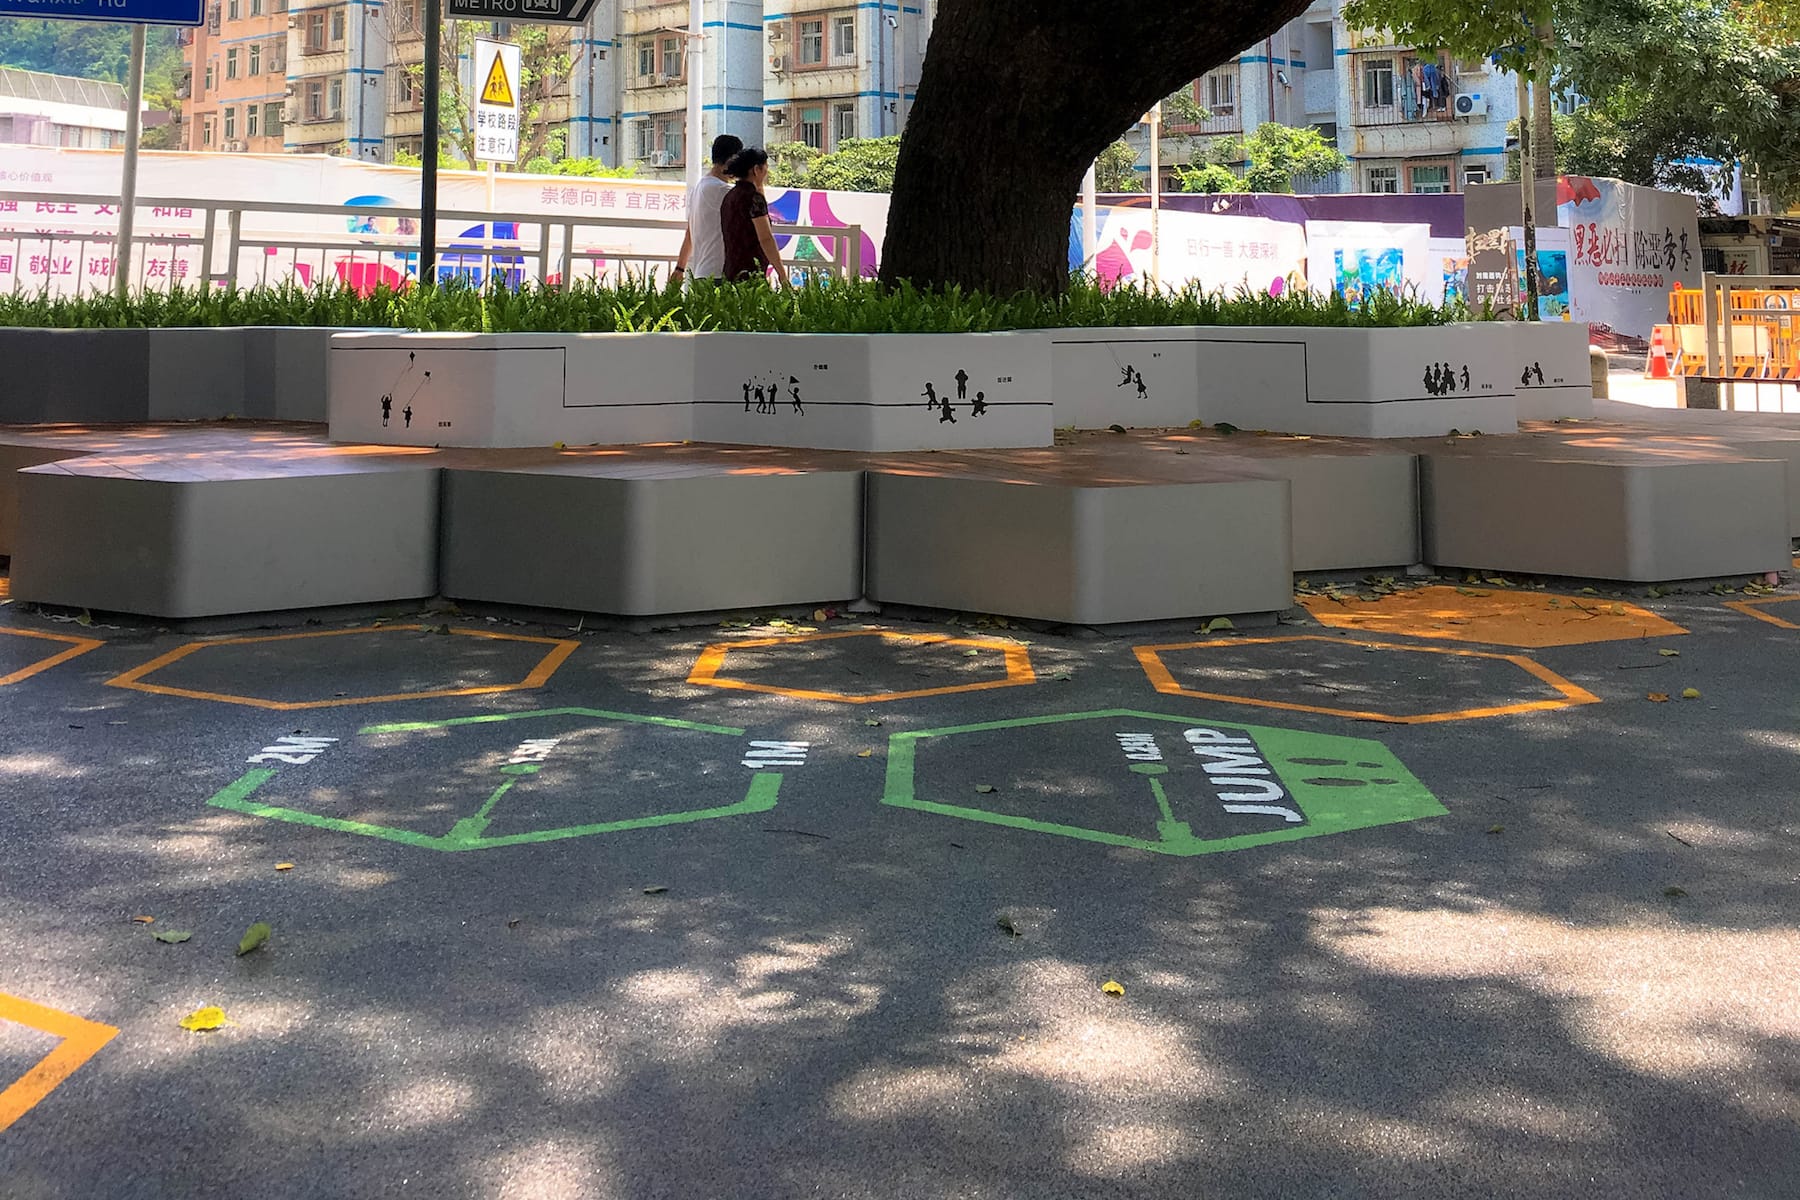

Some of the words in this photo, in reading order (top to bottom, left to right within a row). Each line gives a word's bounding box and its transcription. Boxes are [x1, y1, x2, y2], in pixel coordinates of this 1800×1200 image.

[478, 110, 516, 130] 学校路段
[478, 135, 515, 154] 注意行人
[541, 186, 616, 208] 崇德向善
[625, 191, 687, 211] 宜居深
[29, 255, 72, 275] 敬业
[147, 258, 189, 278] 友善
[245, 737, 340, 764] 2M
[741, 741, 810, 769] 1M
[1183, 728, 1304, 822] JUMP
